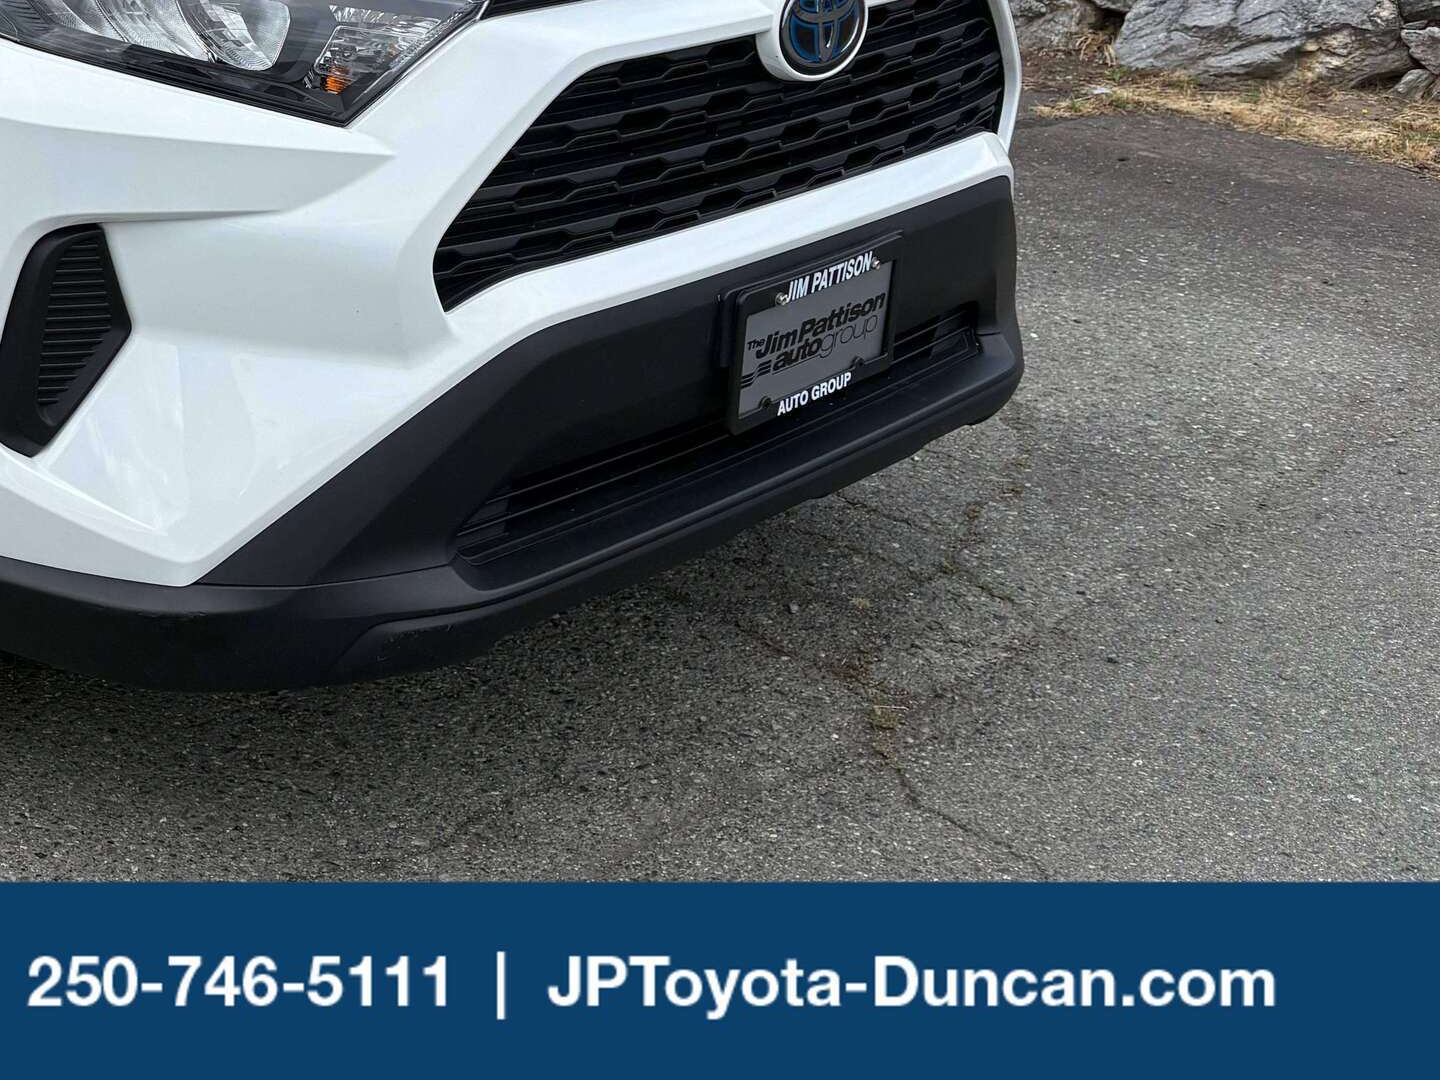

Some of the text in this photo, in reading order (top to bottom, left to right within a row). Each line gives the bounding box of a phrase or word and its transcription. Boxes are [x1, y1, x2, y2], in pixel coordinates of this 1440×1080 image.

[785, 251, 873, 305] JIM PATTISON
[776, 371, 852, 417] AUTO GROUP
